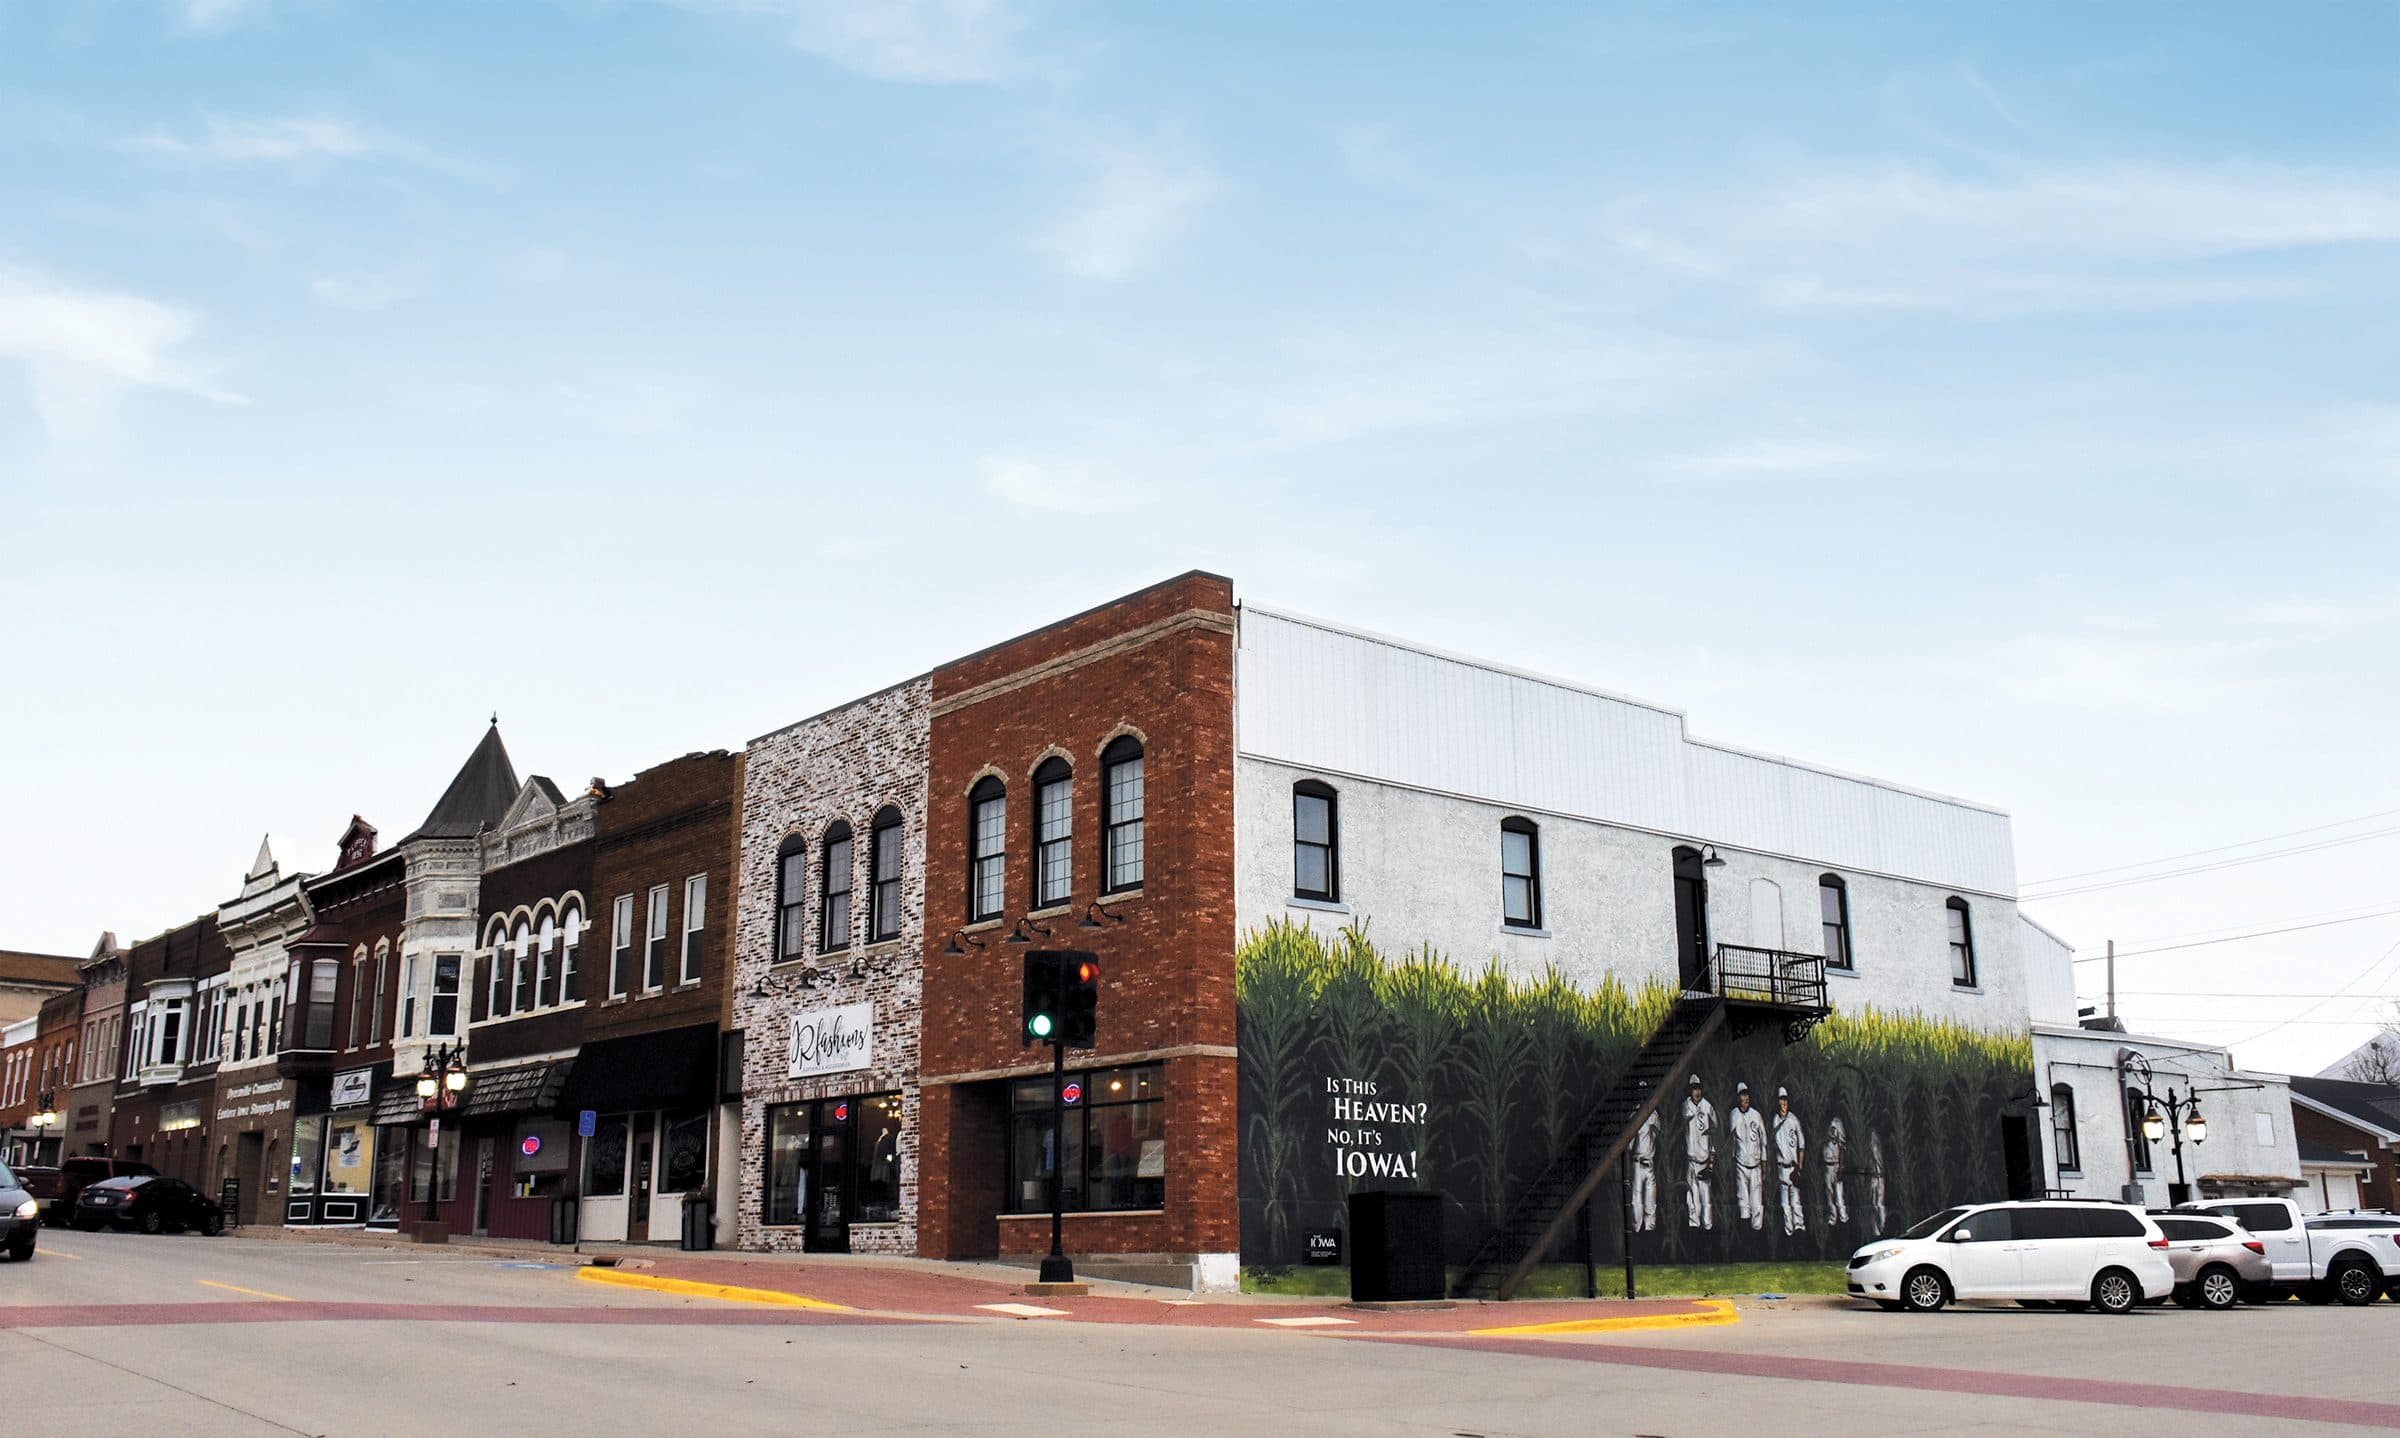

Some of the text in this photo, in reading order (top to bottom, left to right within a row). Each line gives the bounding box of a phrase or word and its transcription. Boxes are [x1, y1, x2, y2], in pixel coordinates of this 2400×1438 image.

[1326, 1077, 1377, 1095] IS THIS
[1334, 1097, 1428, 1125] HEAVEN?
[1327, 1128, 1382, 1146] NO, IT'S
[1336, 1147, 1418, 1179] IOWA!
